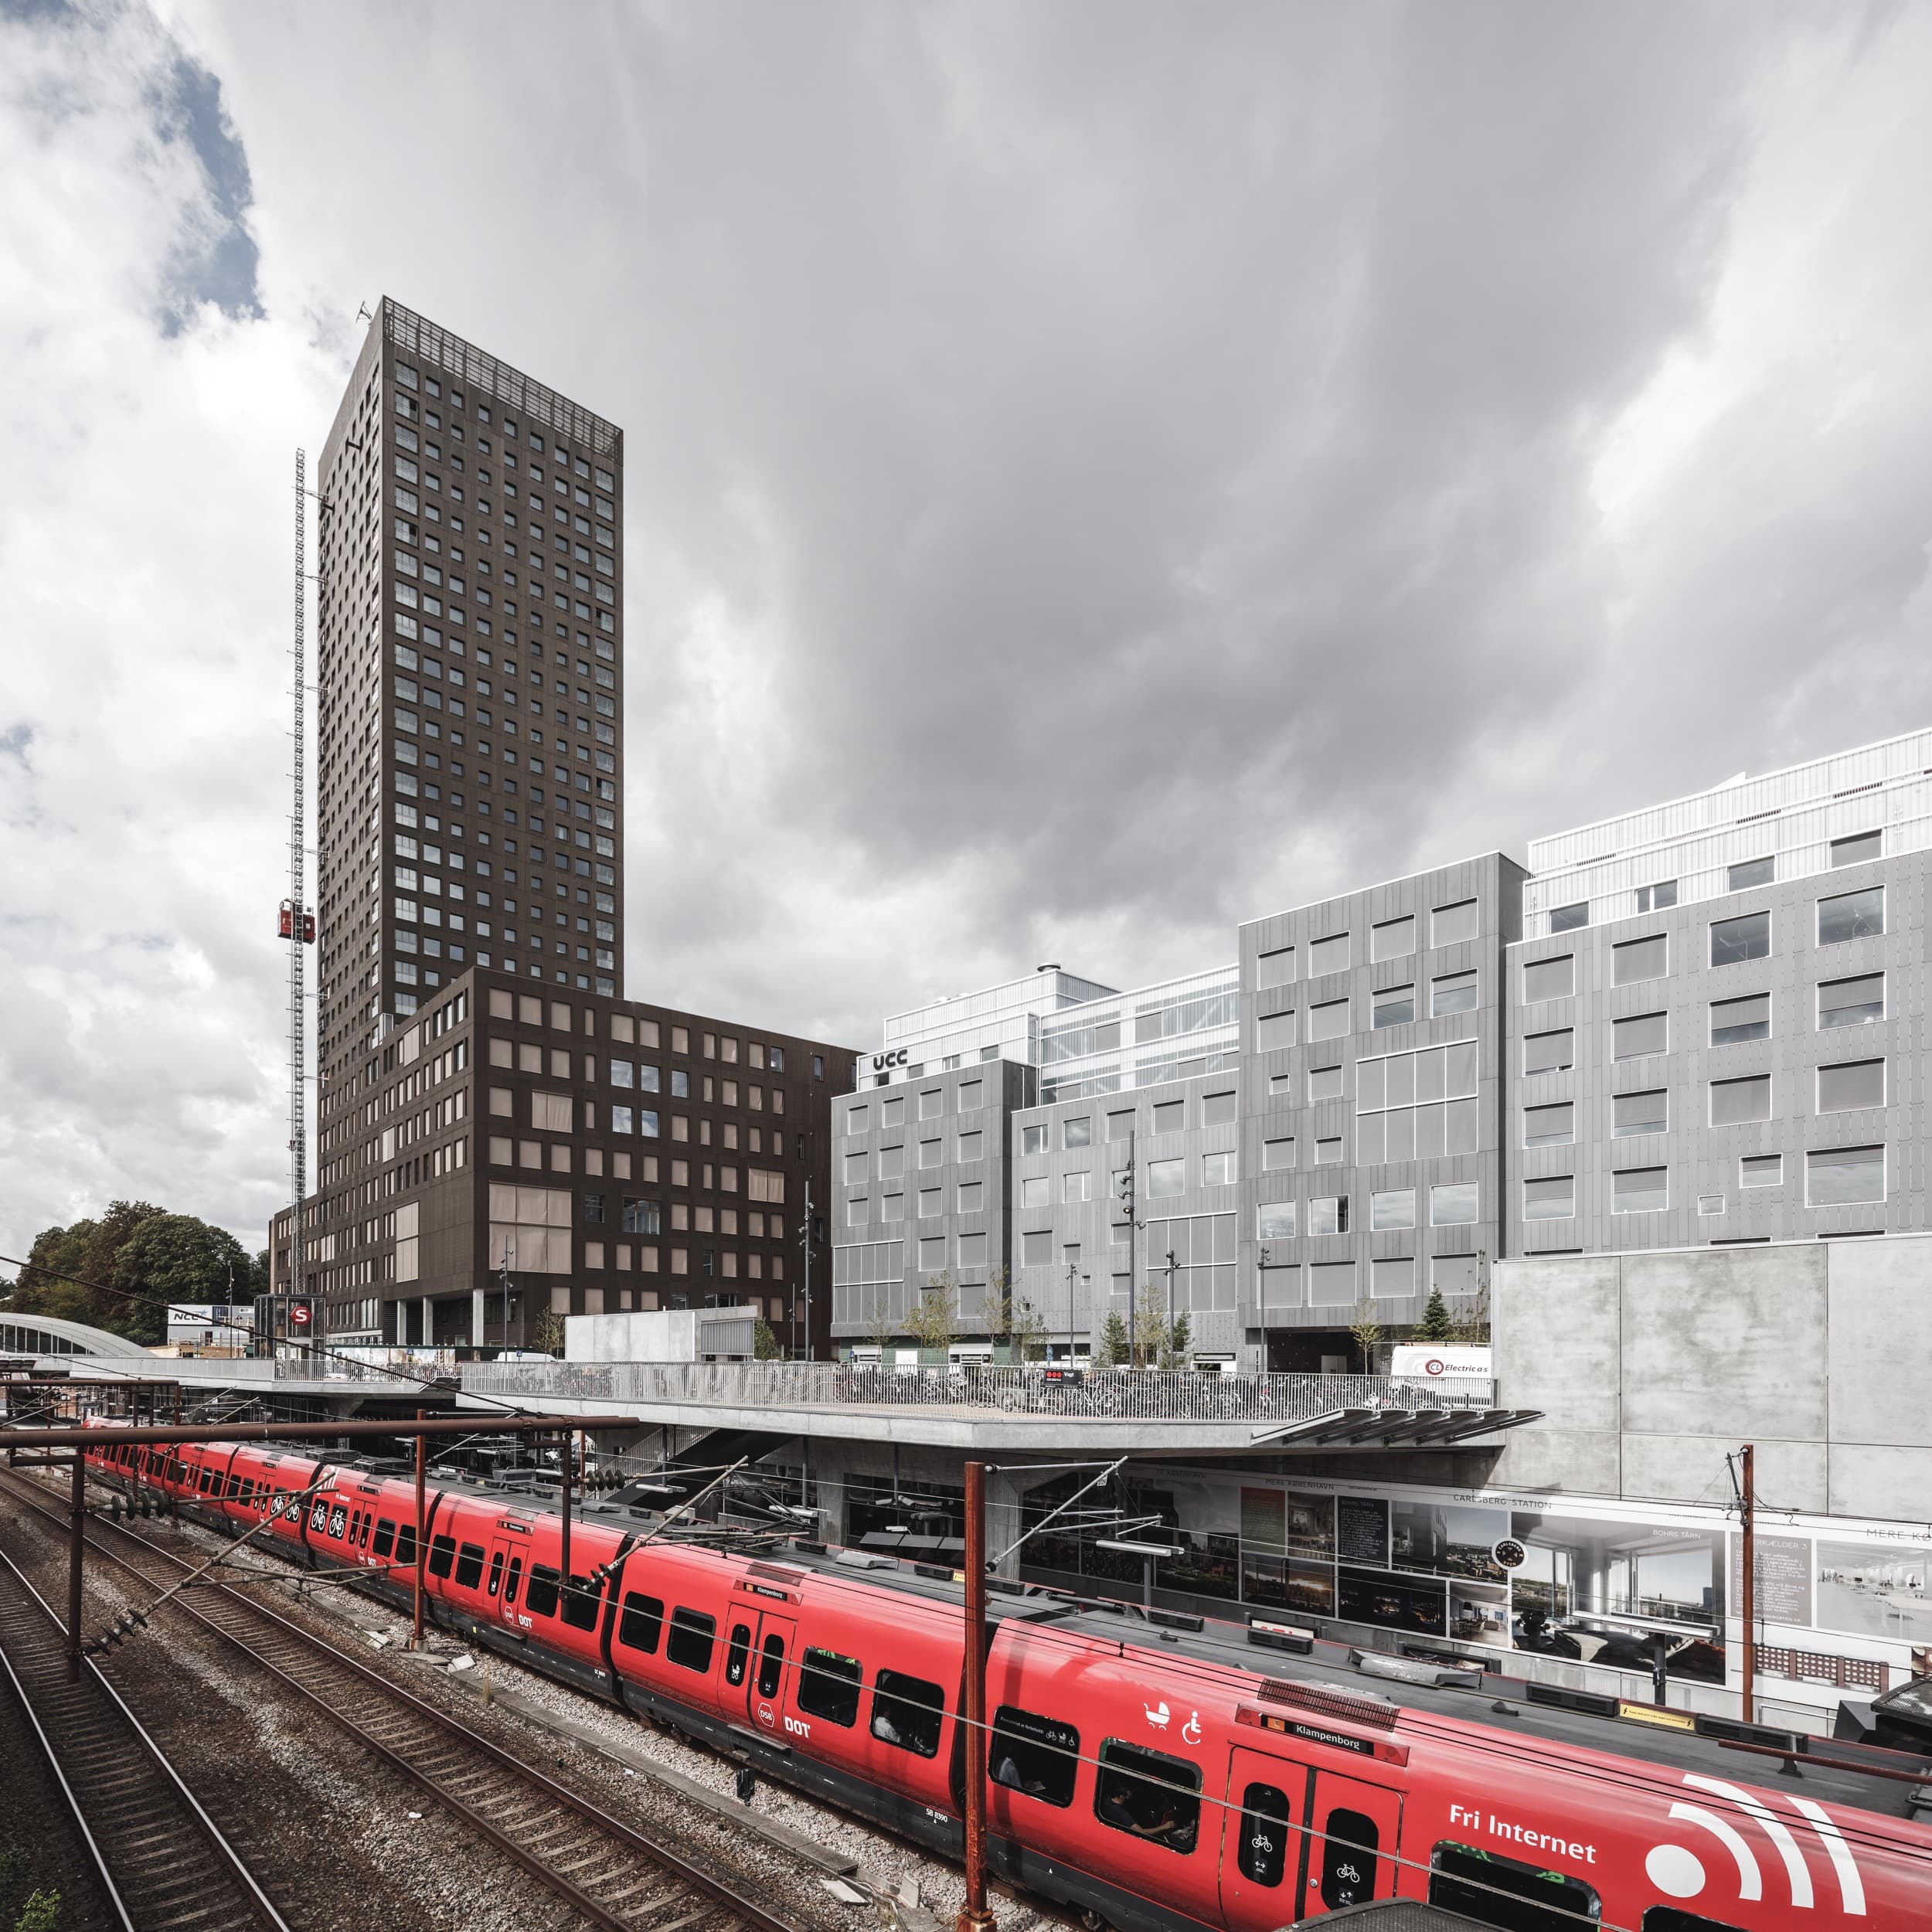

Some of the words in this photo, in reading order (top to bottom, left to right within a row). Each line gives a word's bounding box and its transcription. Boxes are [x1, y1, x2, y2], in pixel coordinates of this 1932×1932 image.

[873, 1049, 907, 1070] UCC
[295, 1310, 308, 1322] S
[1444, 1364, 1475, 1372] Electric
[1265, 1478, 1285, 1486] MERE
[1287, 1480, 1335, 1491] KØBENHAVN
[1453, 1494, 1507, 1505] CARLSBERG
[1512, 1499, 1552, 1509] STATION
[1653, 1529, 1679, 1538] BOHRS
[1681, 1531, 1701, 1539] TÅRN
[1866, 1529, 1905, 1539] MERE
[757, 1587, 783, 1599] Klampenborg
[518, 1614, 532, 1629] DOT
[760, 1709, 773, 1721] DSB
[784, 1716, 811, 1738] DOT
[1296, 1724, 1360, 1750] Klampenborg
[926, 1808, 934, 1817] SB
[1450, 1804, 1481, 1830] Fri
[1489, 1815, 1597, 1864] Internet
